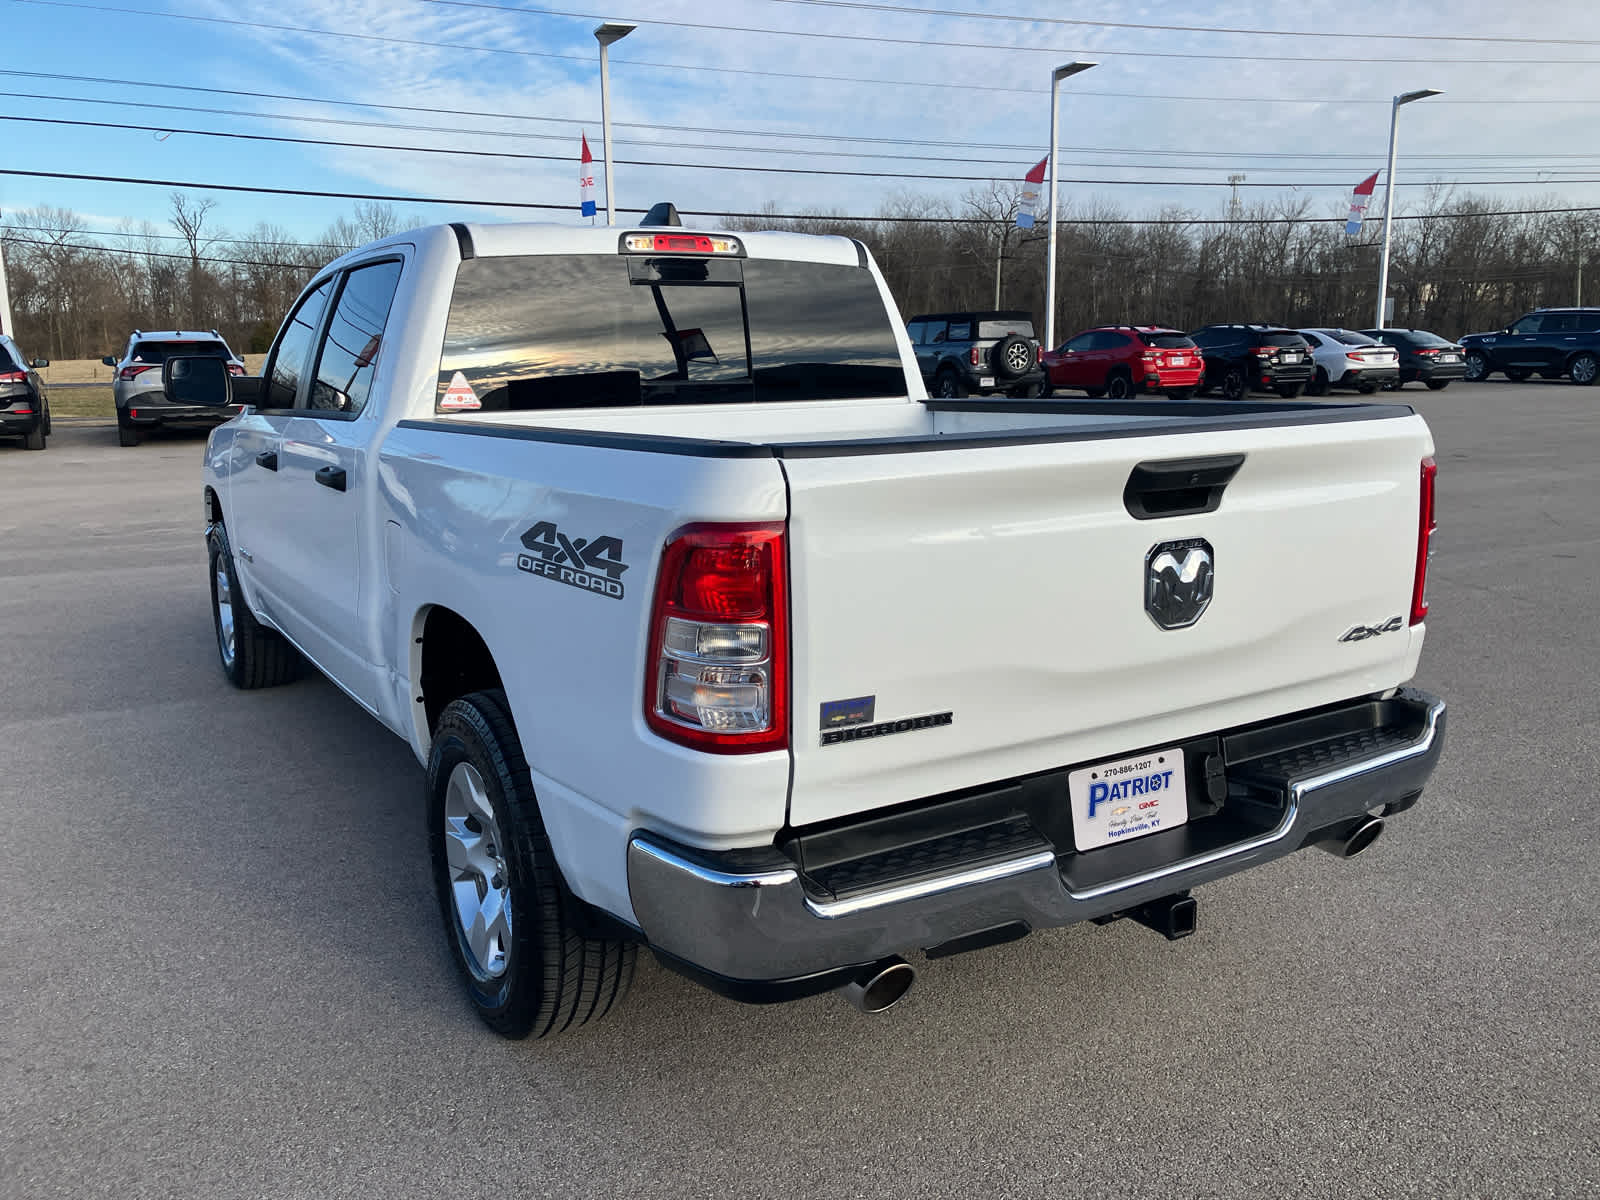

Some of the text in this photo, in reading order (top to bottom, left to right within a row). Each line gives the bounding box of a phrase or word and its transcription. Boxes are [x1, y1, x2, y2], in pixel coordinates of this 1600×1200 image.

[519, 556, 622, 596] OFF ROAD
[1138, 799, 1160, 810] GMC
[1151, 819, 1161, 827] KY
